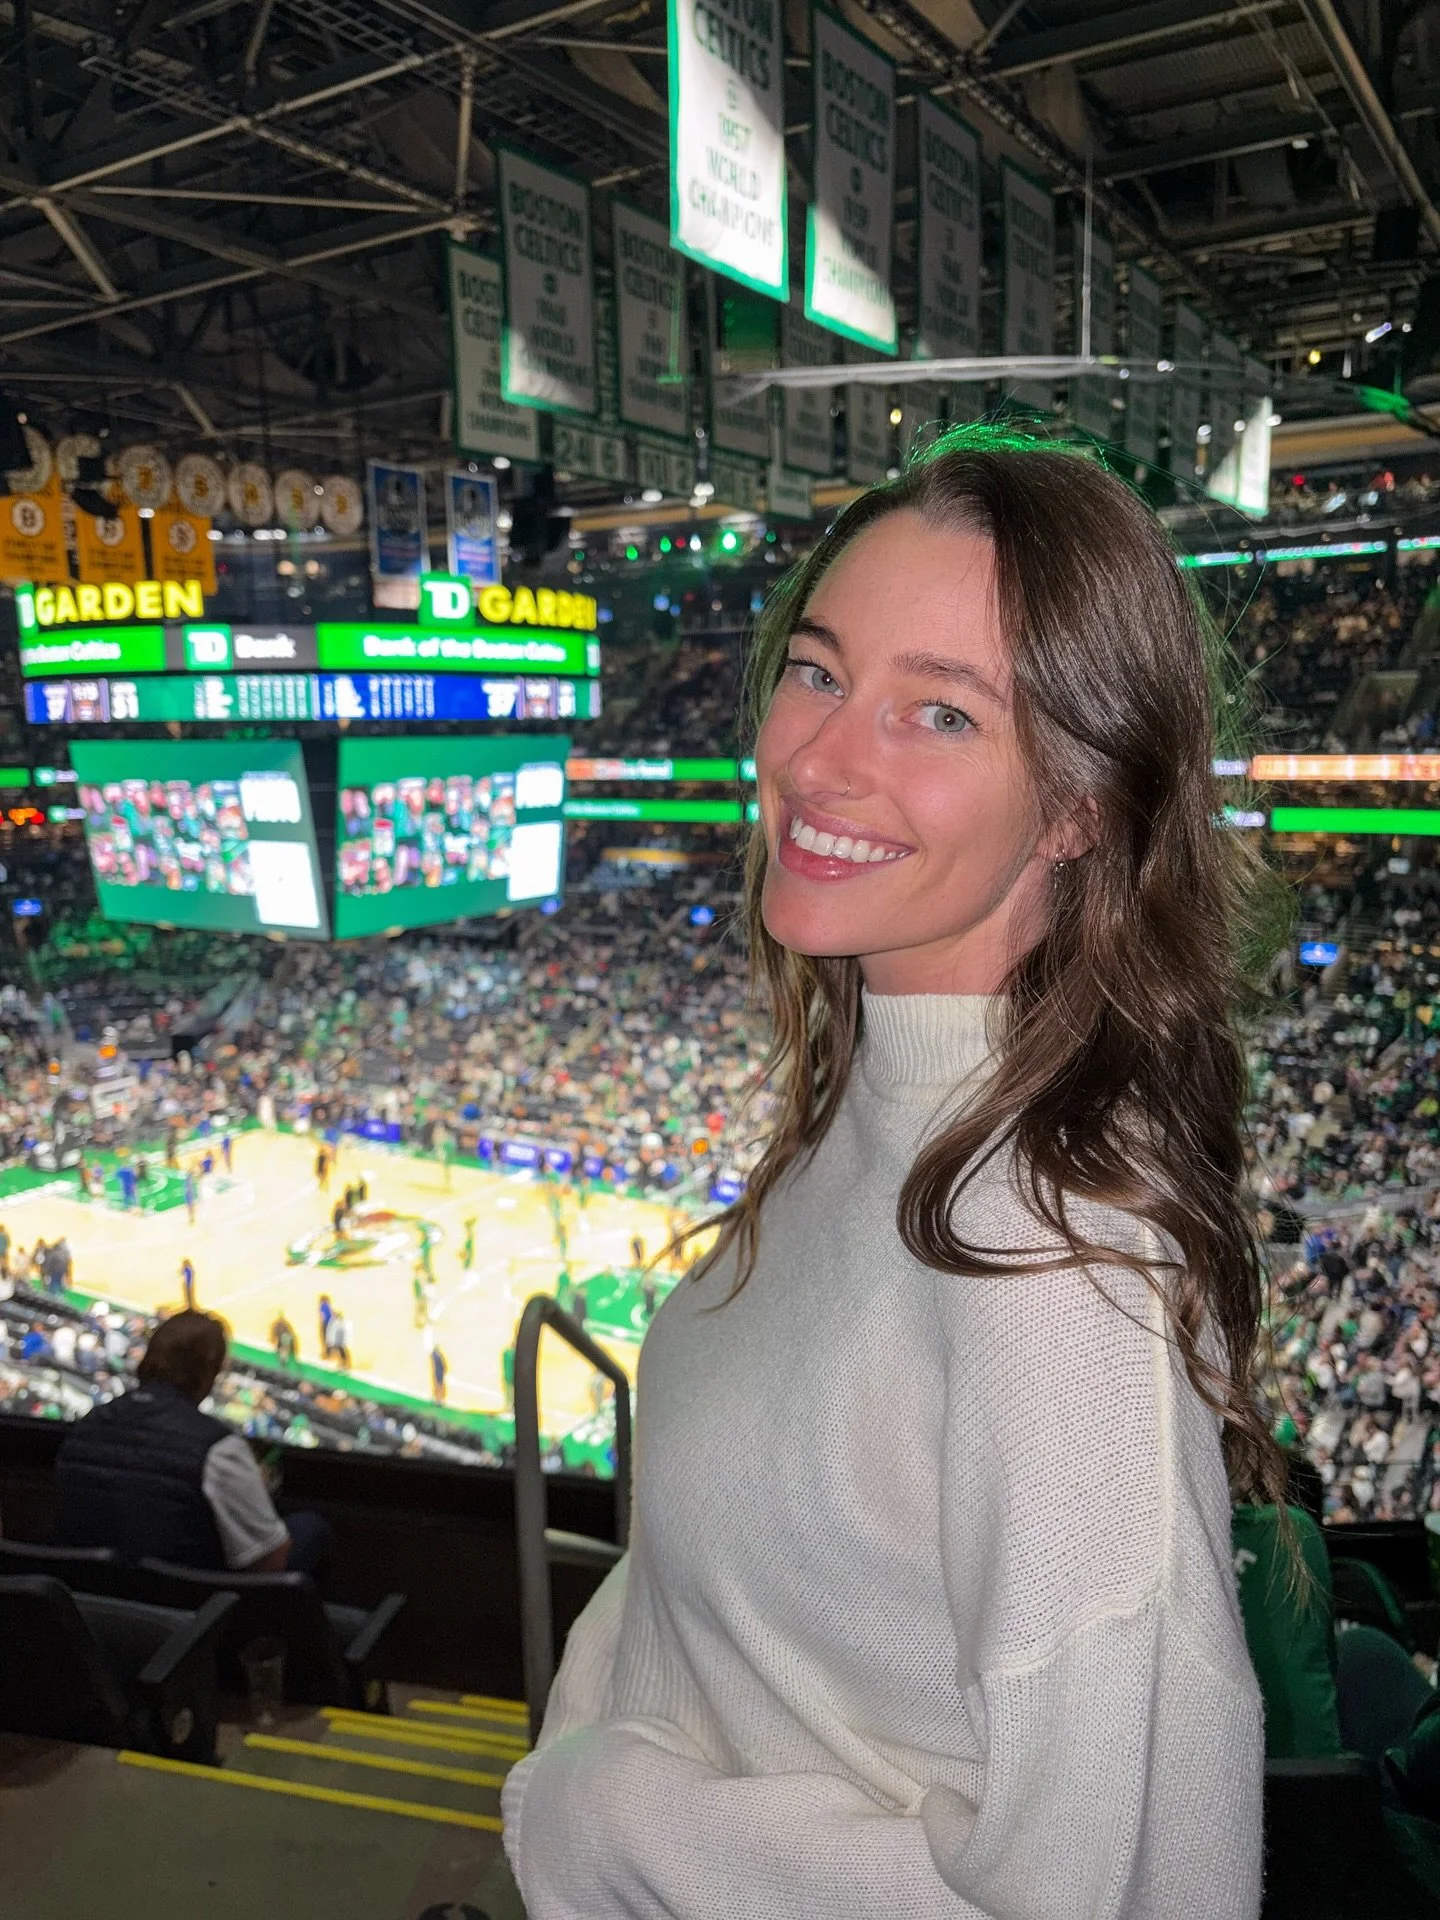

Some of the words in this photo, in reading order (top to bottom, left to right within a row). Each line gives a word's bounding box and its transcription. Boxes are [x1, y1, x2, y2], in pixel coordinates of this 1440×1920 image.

[692, 0, 770, 90] CELTICS
[706, 145, 762, 202] WORLD
[509, 178, 586, 241] BOSTON
[688, 177, 775, 248] CHAMPIONS
[514, 222, 583, 277] CELTICS
[458, 268, 501, 308] BOST
[462, 305, 501, 342] CELT
[35, 579, 204, 626] GARDEN
[424, 580, 470, 619] TD
[478, 583, 598, 631] GARDEN
[188, 631, 228, 662] TD
